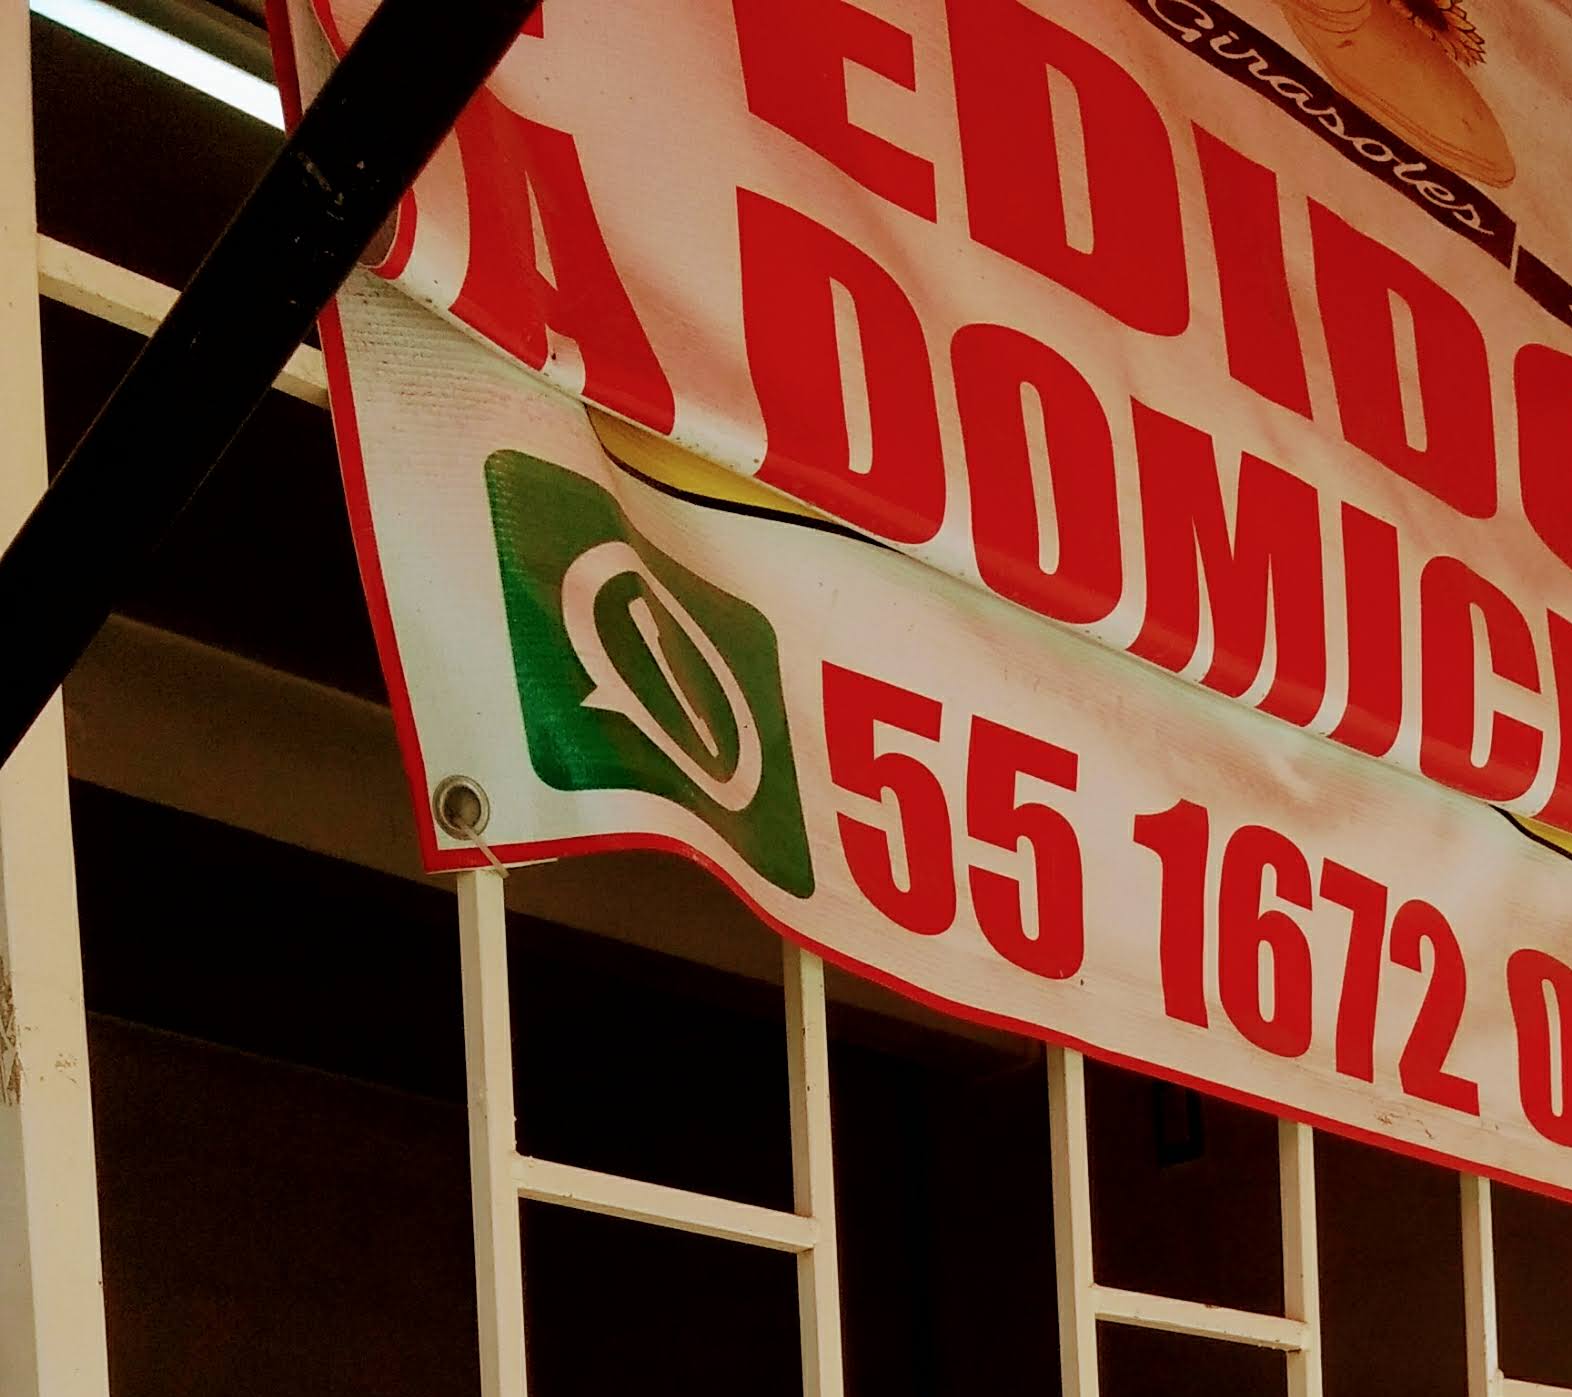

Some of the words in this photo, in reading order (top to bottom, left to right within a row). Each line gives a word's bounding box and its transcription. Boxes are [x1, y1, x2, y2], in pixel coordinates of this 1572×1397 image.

[448, 84, 675, 436] A
[1149, 0, 1494, 235] Girasoles
[821, 665, 1086, 980] 55
[1133, 799, 1480, 1117] 1672
